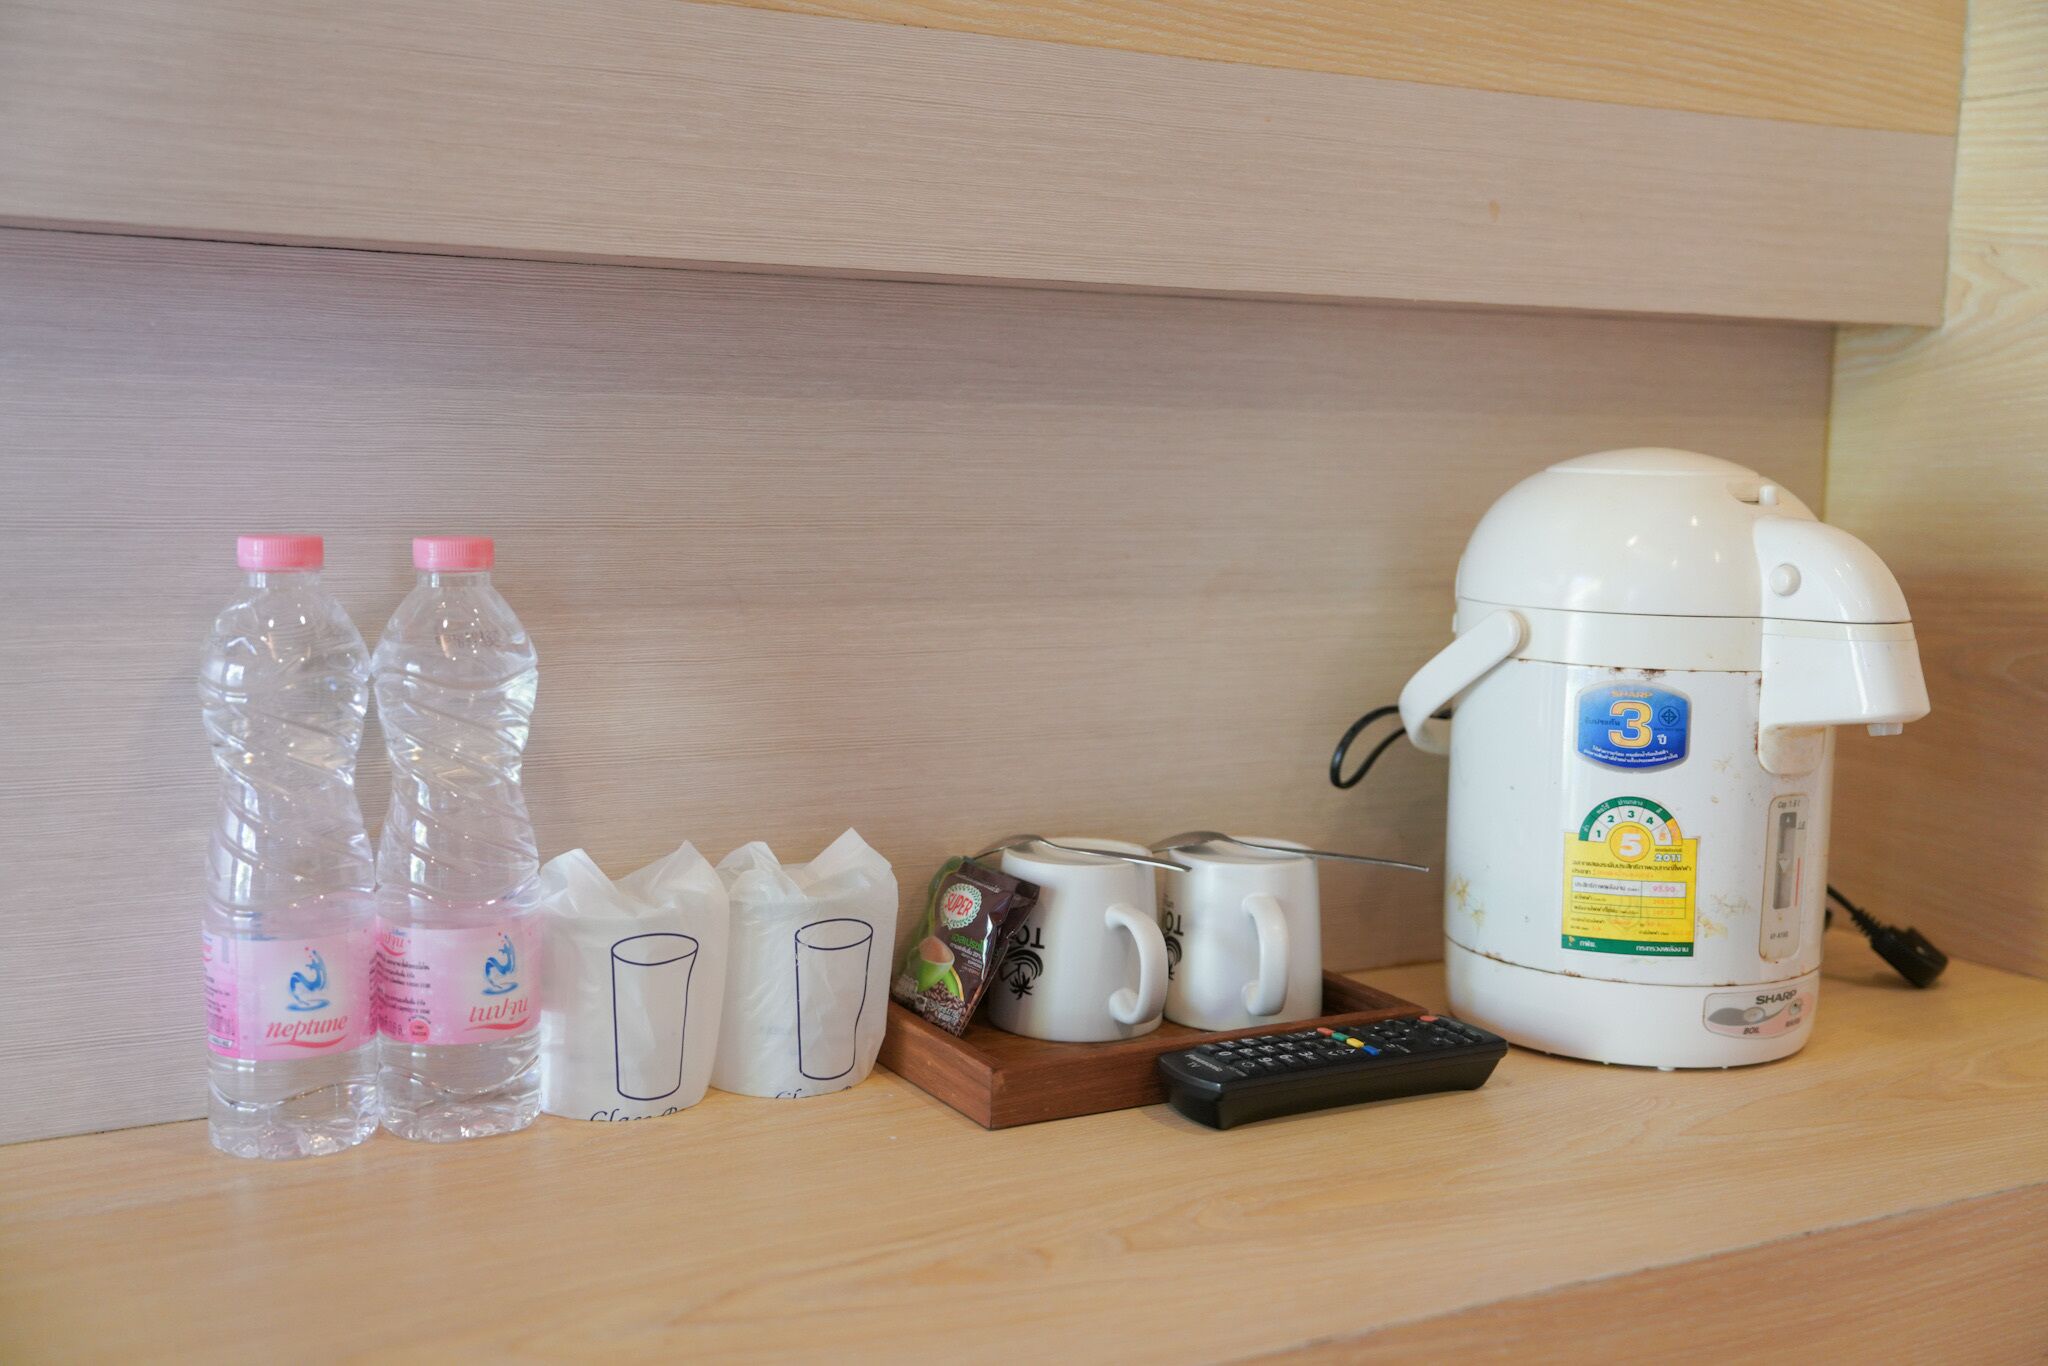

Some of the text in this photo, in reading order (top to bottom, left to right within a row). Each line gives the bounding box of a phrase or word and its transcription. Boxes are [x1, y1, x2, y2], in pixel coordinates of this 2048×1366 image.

[1608, 700, 1653, 749] 3
[1657, 733, 1668, 745] ปี
[1597, 830, 1601, 838] 1
[1607, 815, 1615, 823] 2
[1627, 810, 1635, 818] 3
[1646, 816, 1654, 825] 4
[1619, 832, 1643, 858] 5
[1655, 853, 1682, 863] 2011
[944, 891, 974, 918] SUPER
[1755, 989, 1798, 1006] SHARP
[265, 1015, 348, 1041] neptune
